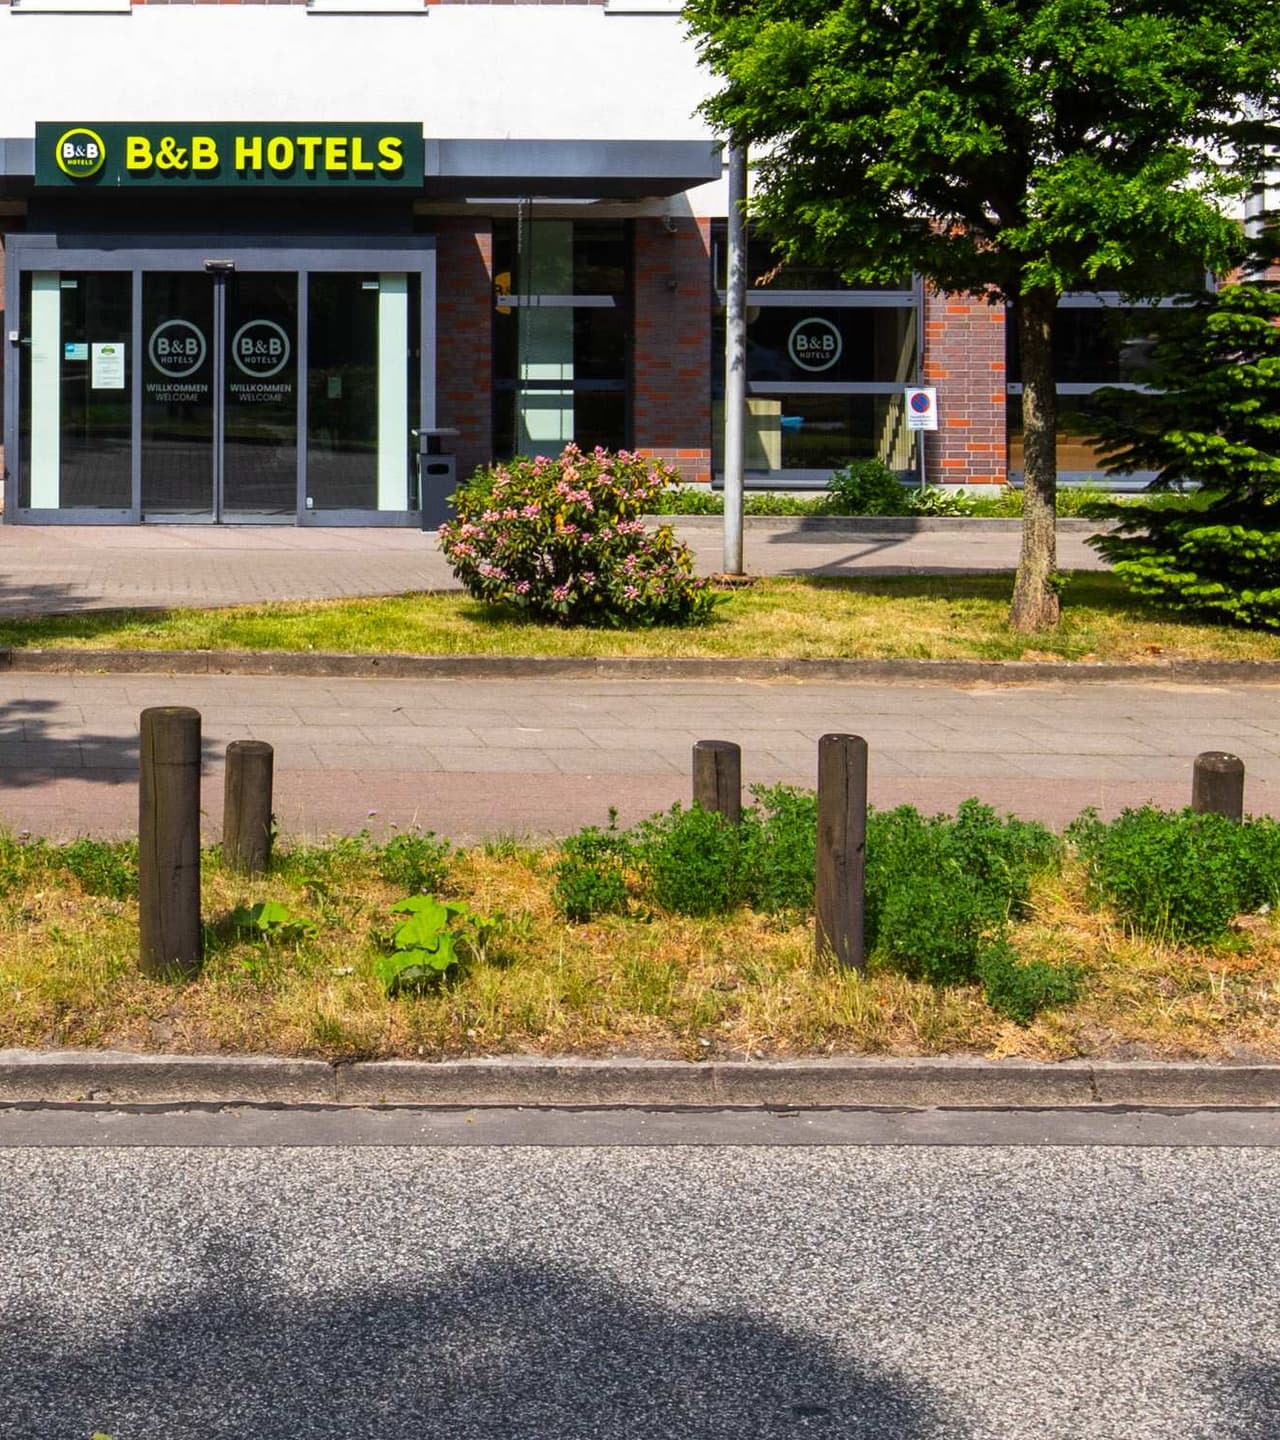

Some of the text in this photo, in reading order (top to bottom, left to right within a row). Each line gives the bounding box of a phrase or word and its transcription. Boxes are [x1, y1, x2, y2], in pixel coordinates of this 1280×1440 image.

[63, 142, 99, 159] B&B
[125, 136, 403, 172] B&B HOTELS
[157, 337, 198, 355] B&B
[241, 337, 282, 355] B&B
[796, 335, 834, 350] B&B
[160, 356, 194, 364] HOTELS
[244, 356, 278, 364] HOTELS
[800, 351, 831, 359] HOTELS
[146, 383, 208, 393] WILLKOMMEN
[230, 383, 292, 393] WILLKOMMEN
[155, 393, 200, 402] WELCOME
[239, 393, 283, 402] WELCOME
